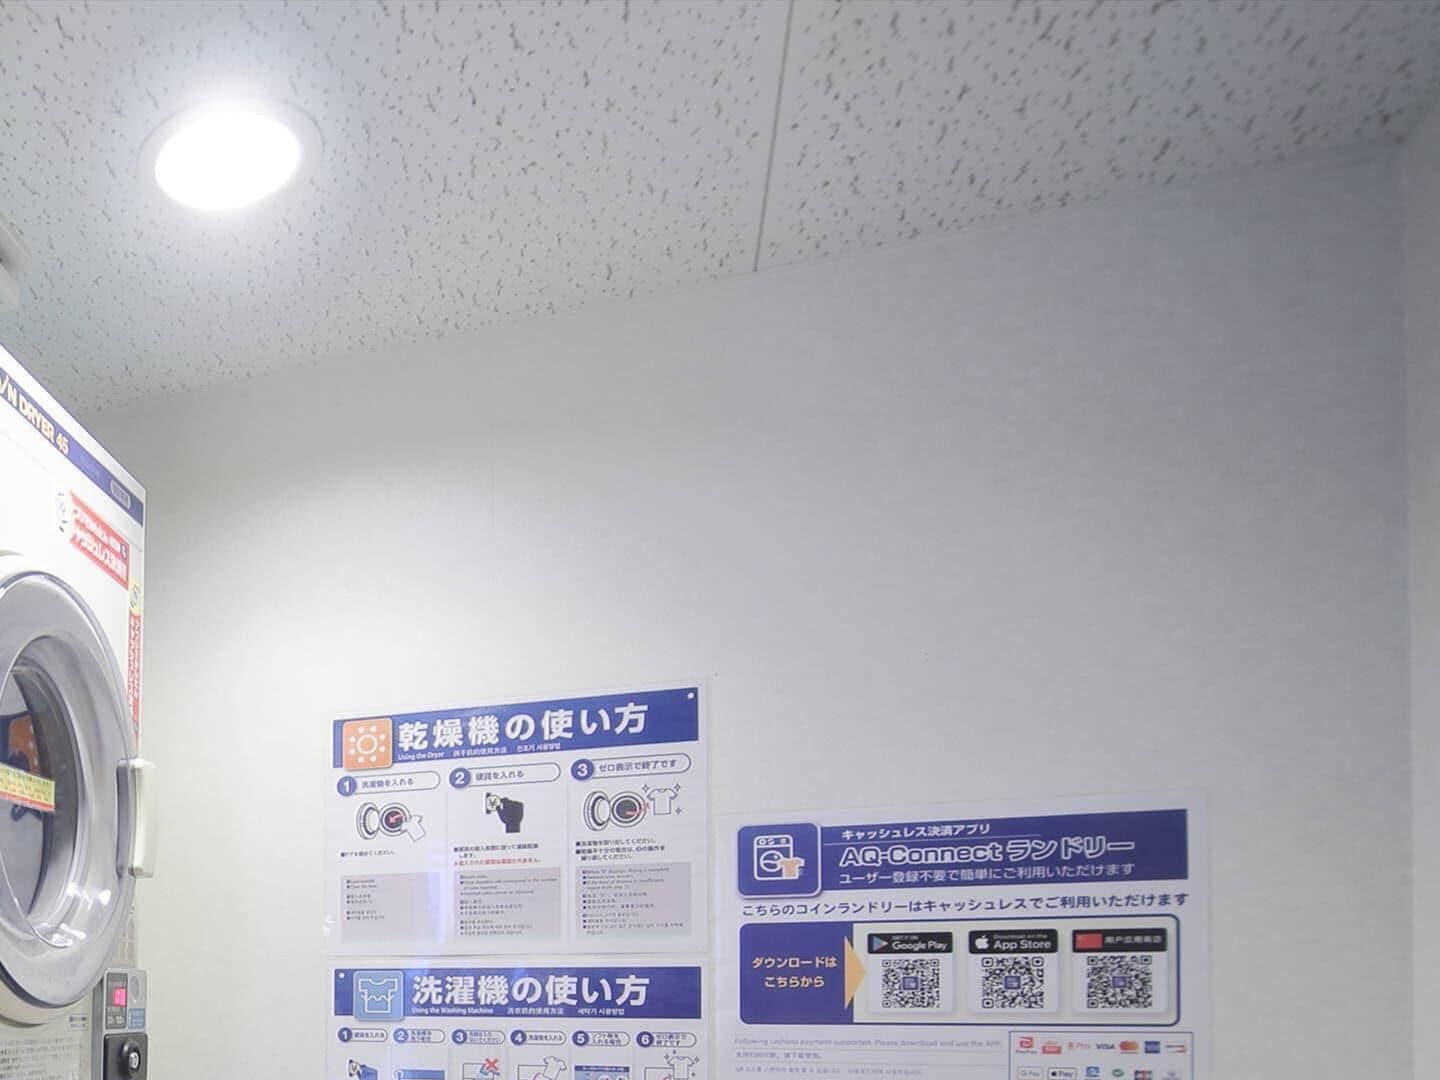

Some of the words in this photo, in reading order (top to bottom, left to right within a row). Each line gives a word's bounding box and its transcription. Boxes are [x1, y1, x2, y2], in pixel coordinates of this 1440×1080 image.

[397, 702, 650, 751] 乾燥機の使い方
[841, 823, 991, 841] キャッシュレス決済アプリ
[840, 843, 1003, 867] AQ-Connect
[1006, 836, 1135, 860] ランドリー
[741, 892, 1191, 918] こちらのコインランドリーはキャッシュレスでご利用いただけます
[892, 941, 924, 951] Google
[926, 941, 948, 951] Play
[993, 940, 1012, 951] App
[1014, 939, 1051, 950] Store
[752, 956, 838, 971] ダウンロードは
[412, 975, 651, 1007] 洗濯機の使い方
[764, 975, 826, 989] こちらから
